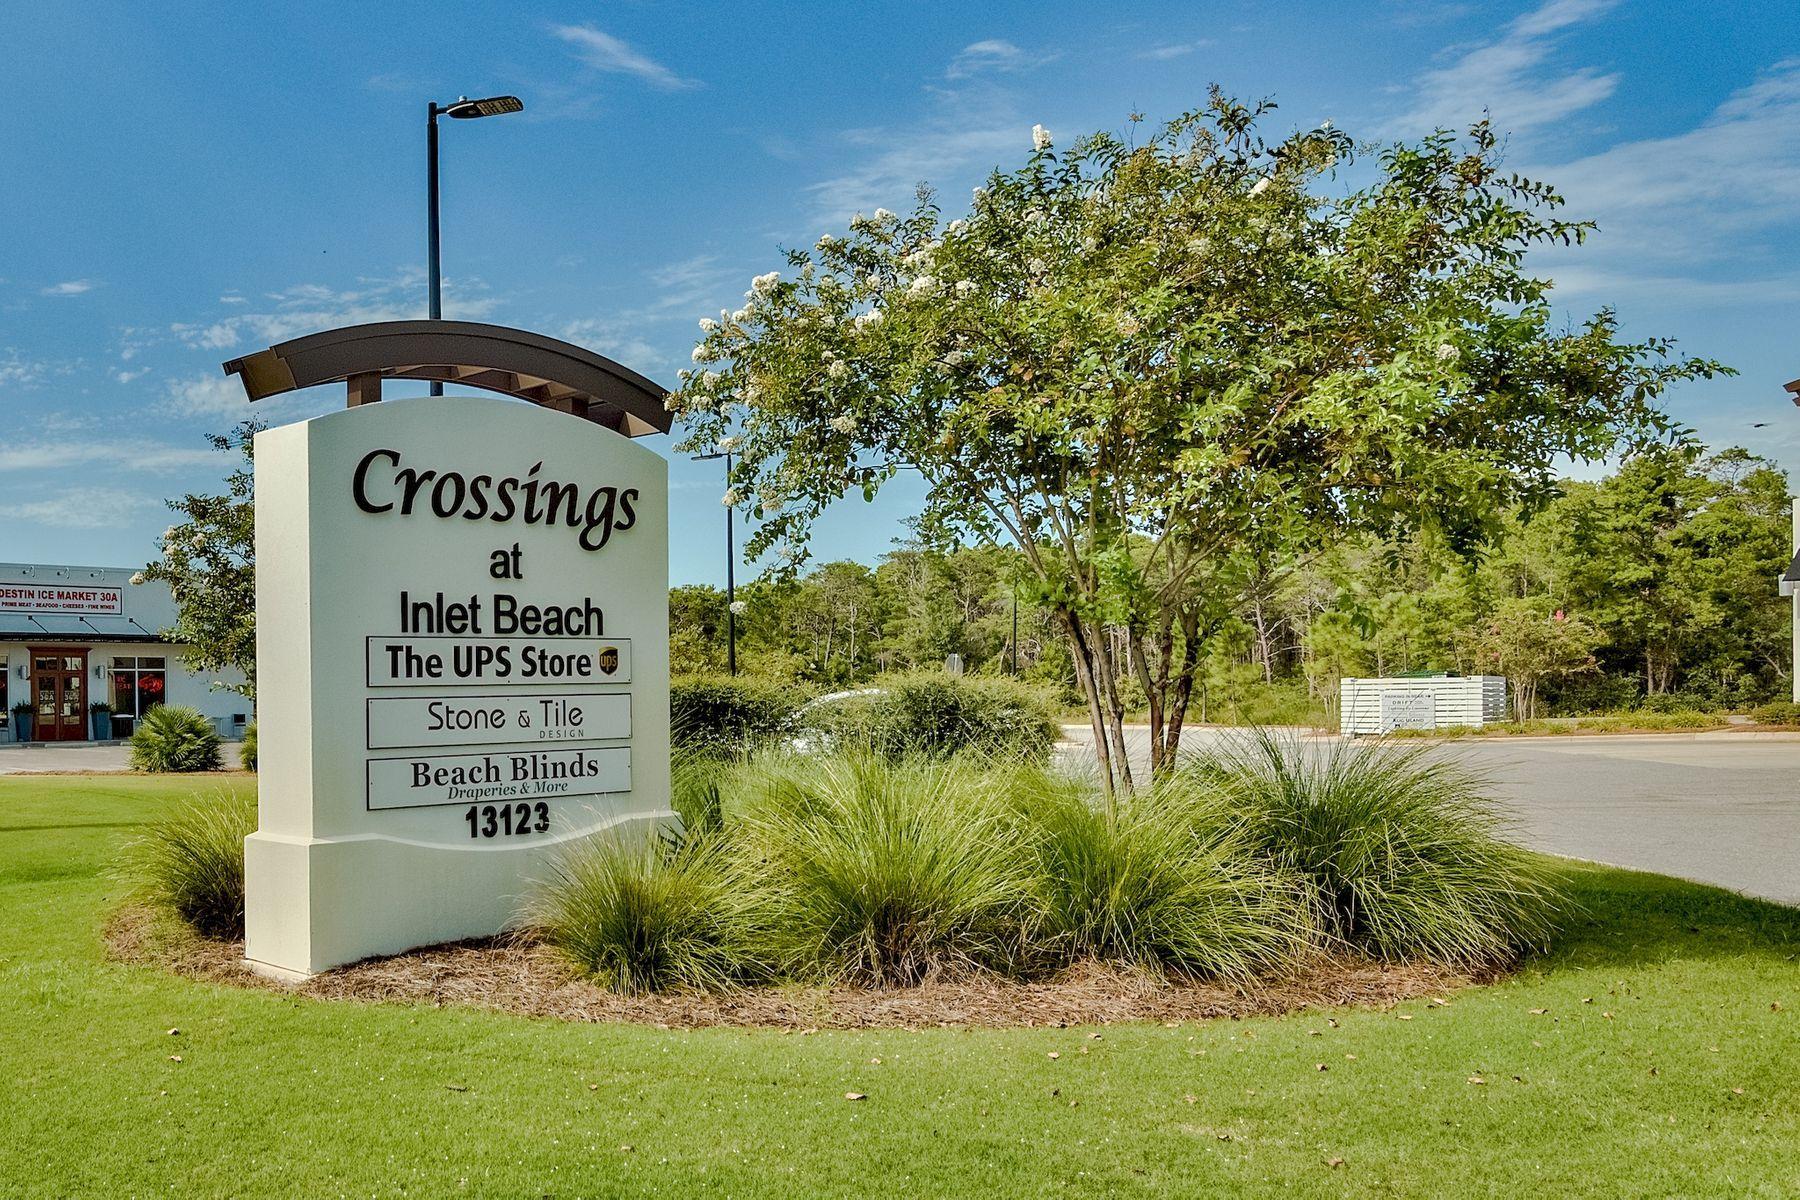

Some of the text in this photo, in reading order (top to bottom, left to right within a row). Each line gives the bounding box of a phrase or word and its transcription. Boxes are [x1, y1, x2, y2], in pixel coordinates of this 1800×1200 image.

[352, 449, 639, 551] Crossings
[489, 542, 523, 579] at
[0, 589, 118, 601] DESTIN ICE MARKET 30A
[400, 591, 604, 636] Inlet Beach
[385, 645, 592, 678] The UPS Store
[428, 699, 583, 730] Stone & Tile
[539, 728, 584, 739] DESIGN
[411, 752, 599, 788] Beach Blinds
[447, 781, 568, 800] Draperies & More
[465, 801, 550, 839] 13123
